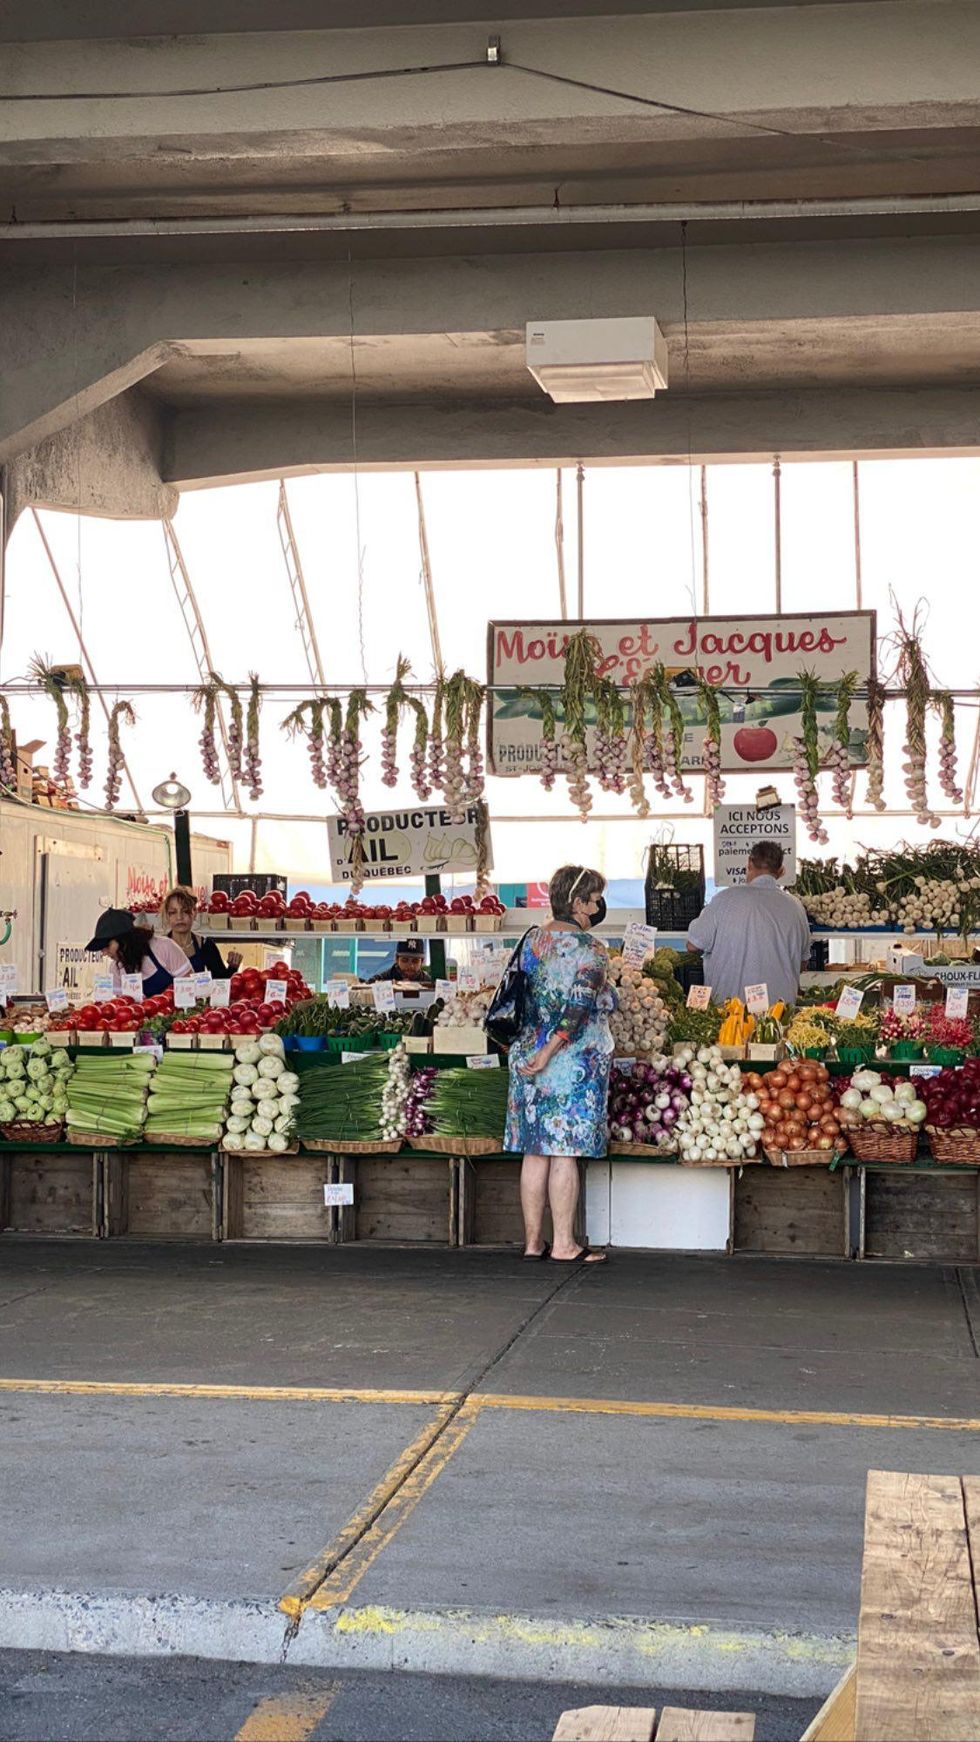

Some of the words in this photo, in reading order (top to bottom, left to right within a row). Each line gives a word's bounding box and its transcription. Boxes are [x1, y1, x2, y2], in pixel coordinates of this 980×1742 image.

[618, 624, 659, 657] et
[673, 622, 847, 663] Jacques
[729, 811, 743, 821] ICI
[747, 811, 781, 821] NOUS
[720, 823, 789, 834] ACCEPTONS
[726, 867, 747, 876] VISA
